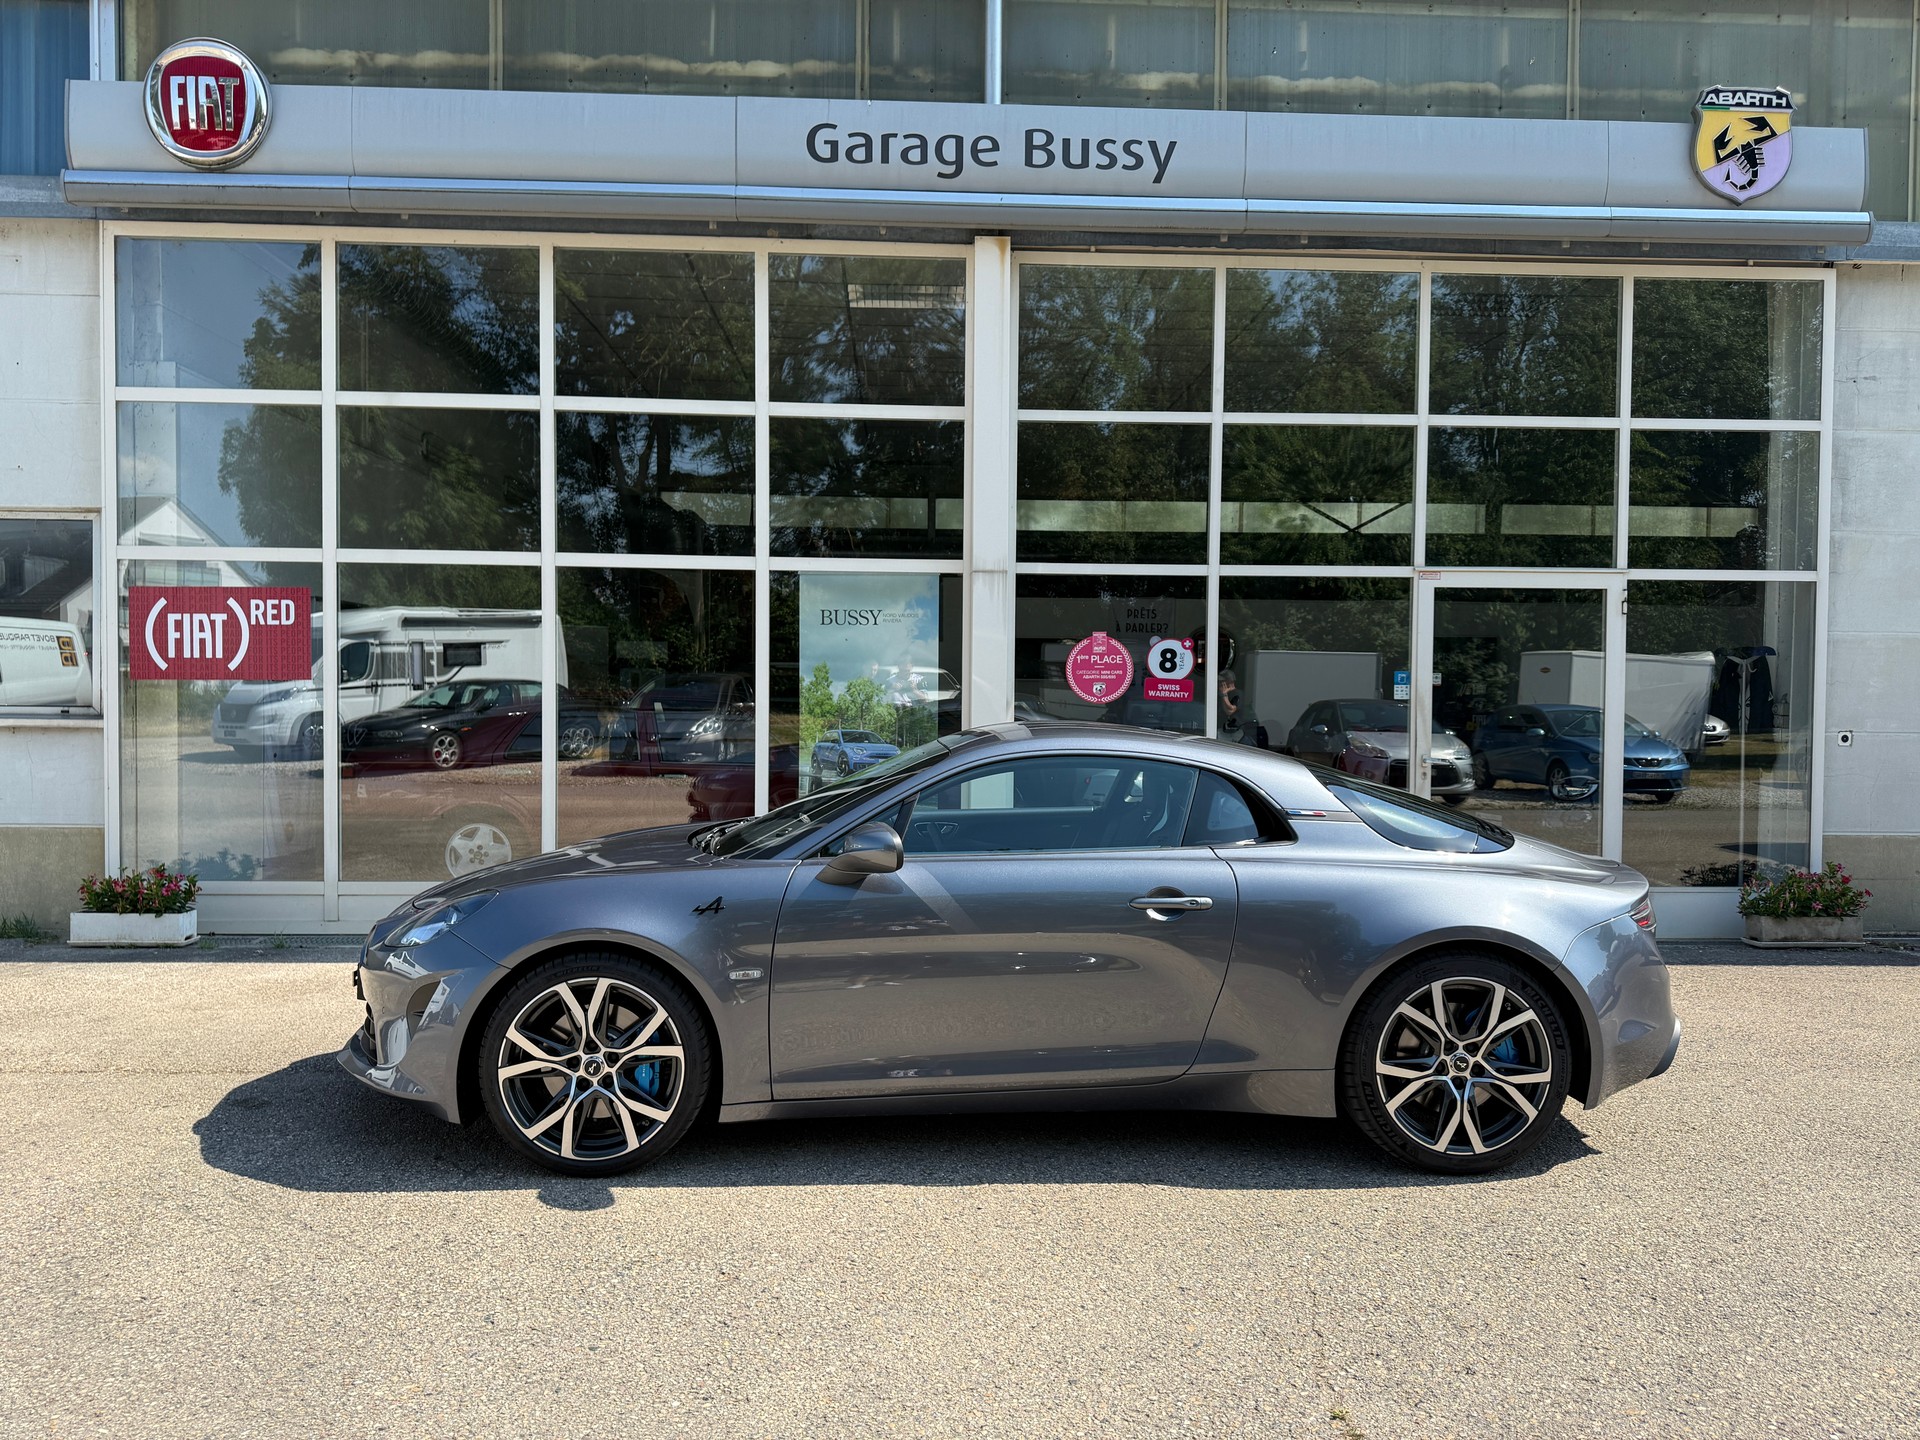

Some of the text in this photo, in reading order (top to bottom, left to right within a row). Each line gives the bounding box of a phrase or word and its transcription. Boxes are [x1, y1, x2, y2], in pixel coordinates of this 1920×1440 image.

[170, 76, 240, 131] FIAT
[1703, 92, 1787, 107] ABARTH
[806, 123, 1178, 184] Garage Bussy
[250, 598, 295, 626] RED
[820, 609, 883, 626] BUSSY
[1127, 607, 1157, 620] PRÊTS
[1126, 623, 1169, 633] PARLER?
[1091, 655, 1123, 664] PLACE
[1159, 648, 1177, 673] 8
[1148, 690, 1189, 699] WARRANTY
